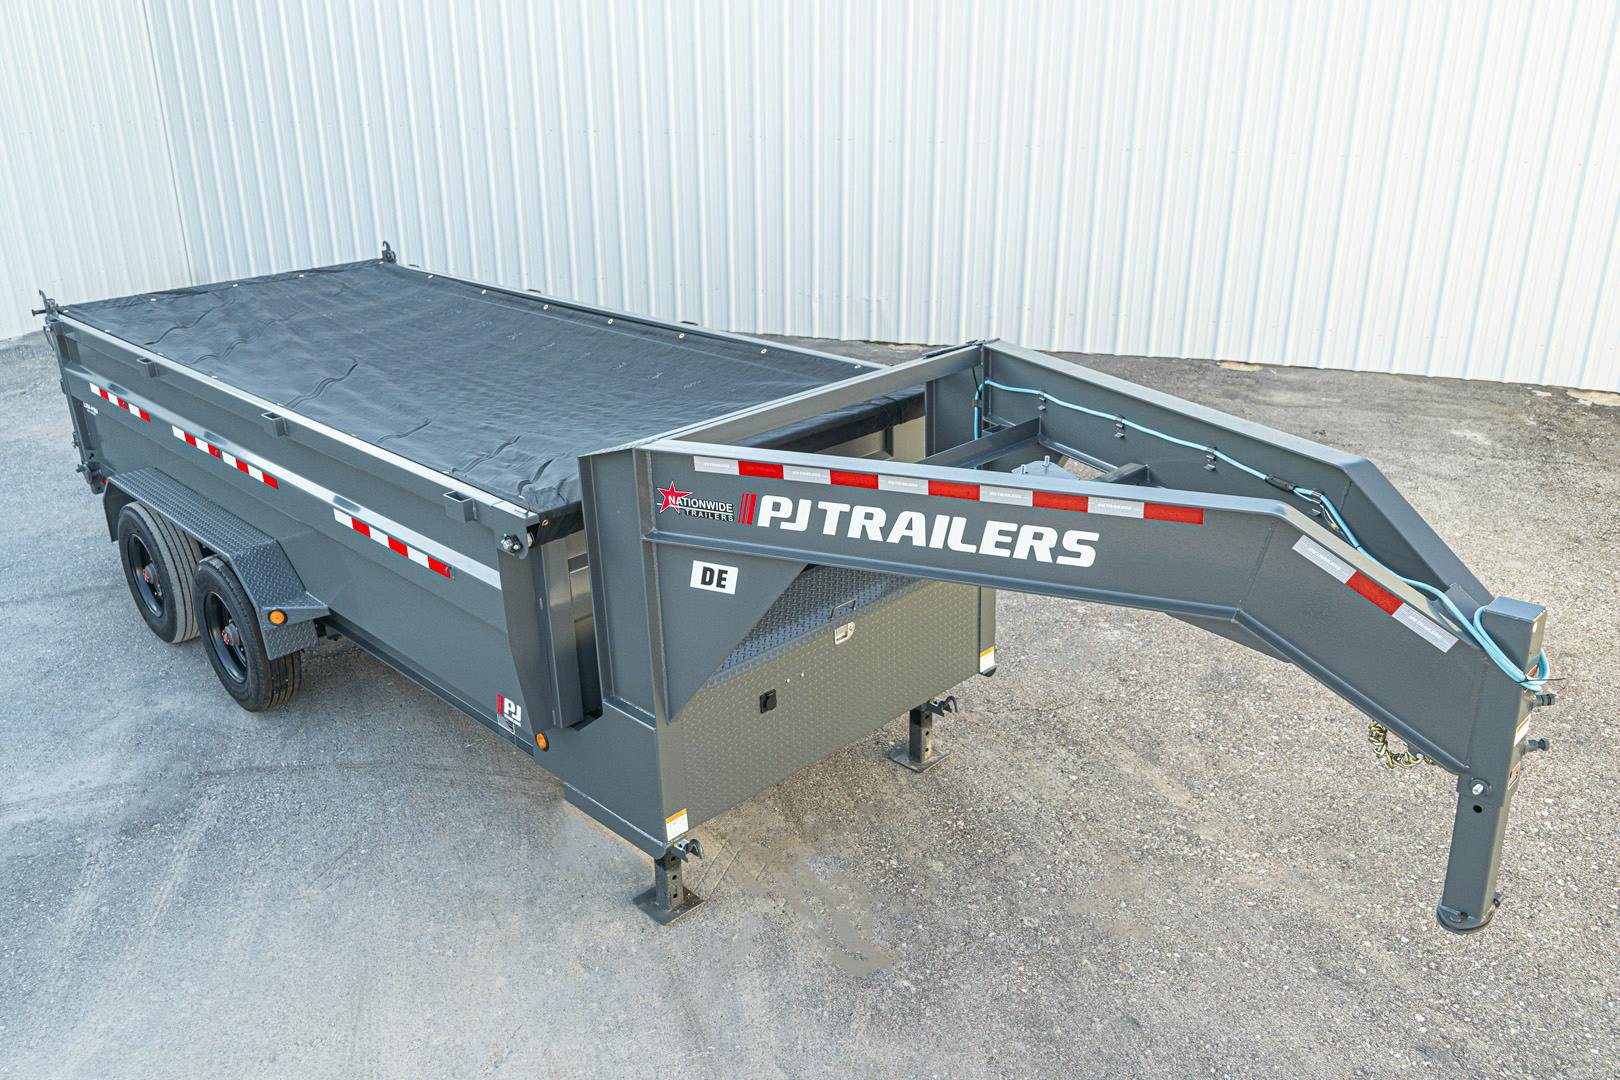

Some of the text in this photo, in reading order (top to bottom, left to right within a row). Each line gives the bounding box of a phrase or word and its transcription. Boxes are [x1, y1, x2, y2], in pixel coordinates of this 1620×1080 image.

[668, 495, 733, 513] NATIONWIDE
[686, 509, 734, 522] TRAILERS
[757, 495, 1100, 568] PJ TRAILERS
[700, 566, 728, 589] DE
[504, 697, 522, 722] PJ
